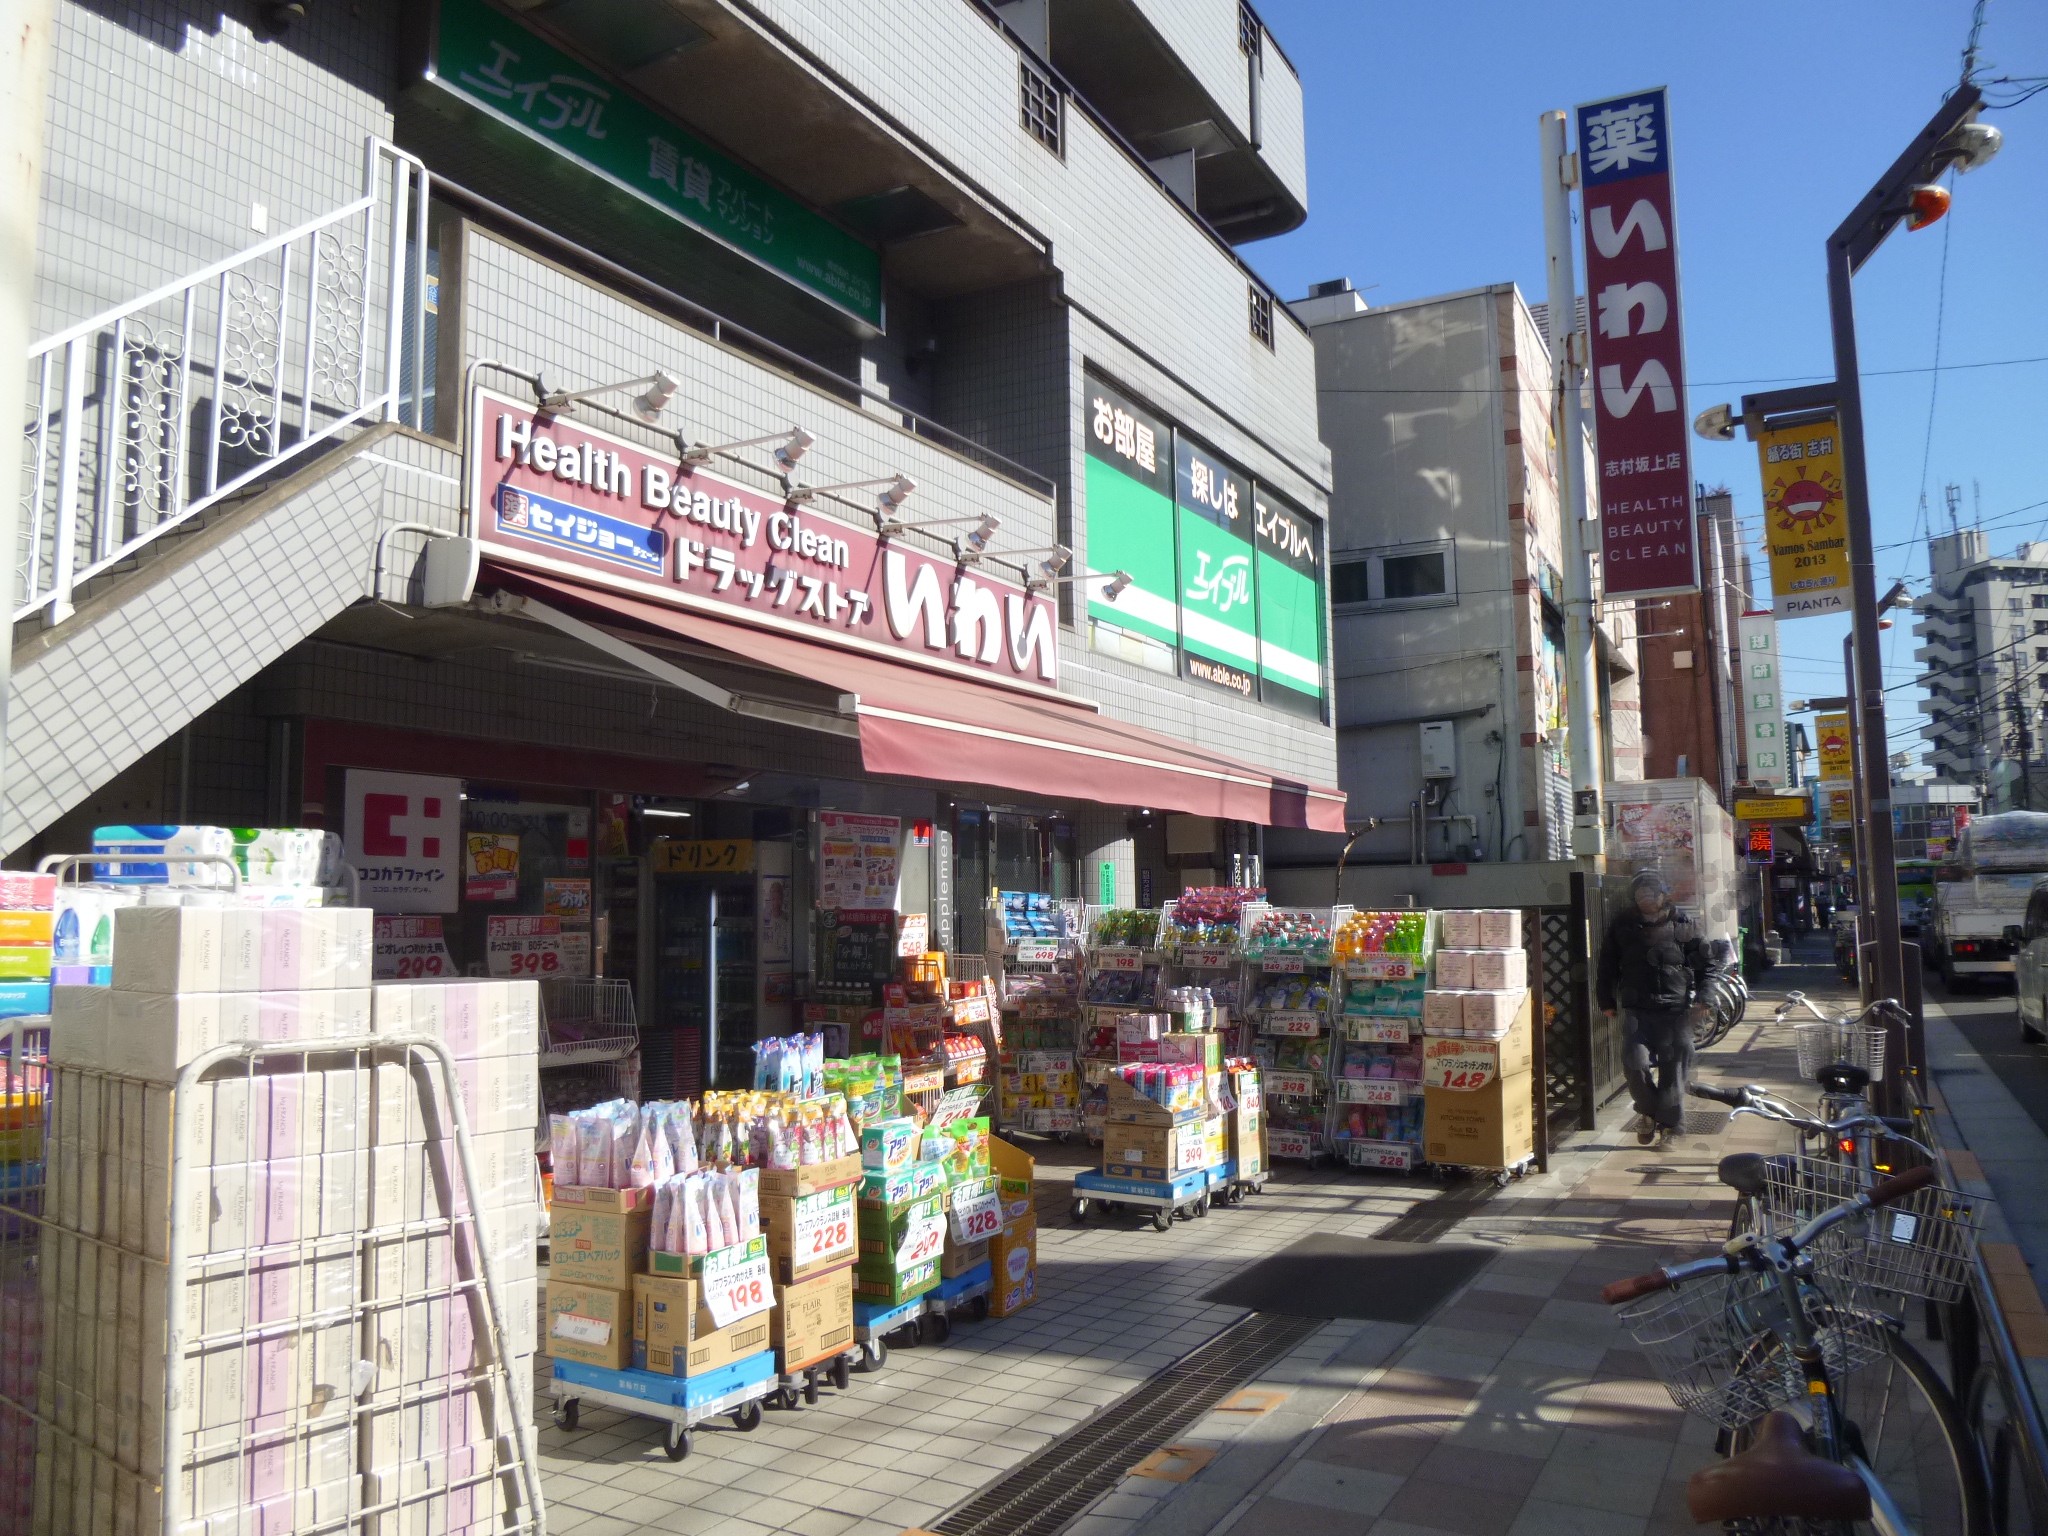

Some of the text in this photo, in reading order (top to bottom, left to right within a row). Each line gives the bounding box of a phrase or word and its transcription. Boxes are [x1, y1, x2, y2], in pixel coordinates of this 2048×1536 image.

[461, 40, 608, 141] エイブル
[1586, 102, 1658, 175] 薬
[647, 135, 712, 213] 賃貸
[1590, 199, 1677, 419] いわい
[1093, 397, 1156, 474] お部屋
[1806, 437, 1834, 459] 志村
[1604, 453, 1681, 477] 志村坂上店
[498, 414, 850, 570] Health Beauty Clean
[1190, 457, 1239, 519] 探しは
[1607, 496, 1683, 515] HEALTH
[530, 503, 634, 550] セイジョー
[1608, 519, 1684, 538] BEAUTY
[1610, 543, 1686, 561] CLEAN
[1773, 537, 1845, 557] Vamos Sambar
[1794, 554, 1826, 569] 2013
[673, 537, 871, 627] ドラッグストア
[1186, 550, 1249, 612] エイブル
[881, 547, 1057, 680] いわい
[1787, 596, 1842, 613] PIANTA
[1190, 659, 1251, 696] www.able.co.jp
[668, 844, 738, 868] ドリンク
[510, 952, 560, 974] 398
[1035, 951, 1054, 960] 698
[1116, 958, 1134, 967] 198
[1203, 955, 1219, 965] 79
[397, 956, 443, 978] 299
[1288, 1022, 1311, 1032] 229
[1282, 1082, 1305, 1092] 398
[1443, 1070, 1485, 1088] 148
[1367, 1091, 1392, 1101] 248
[1186, 1149, 1202, 1163] 399
[1280, 1143, 1304, 1154] 399
[1379, 1155, 1403, 1166] 228
[967, 1211, 998, 1236] 328
[813, 1222, 847, 1252] 228
[728, 1281, 763, 1311] 198
[802, 1298, 823, 1313] FLAIR
